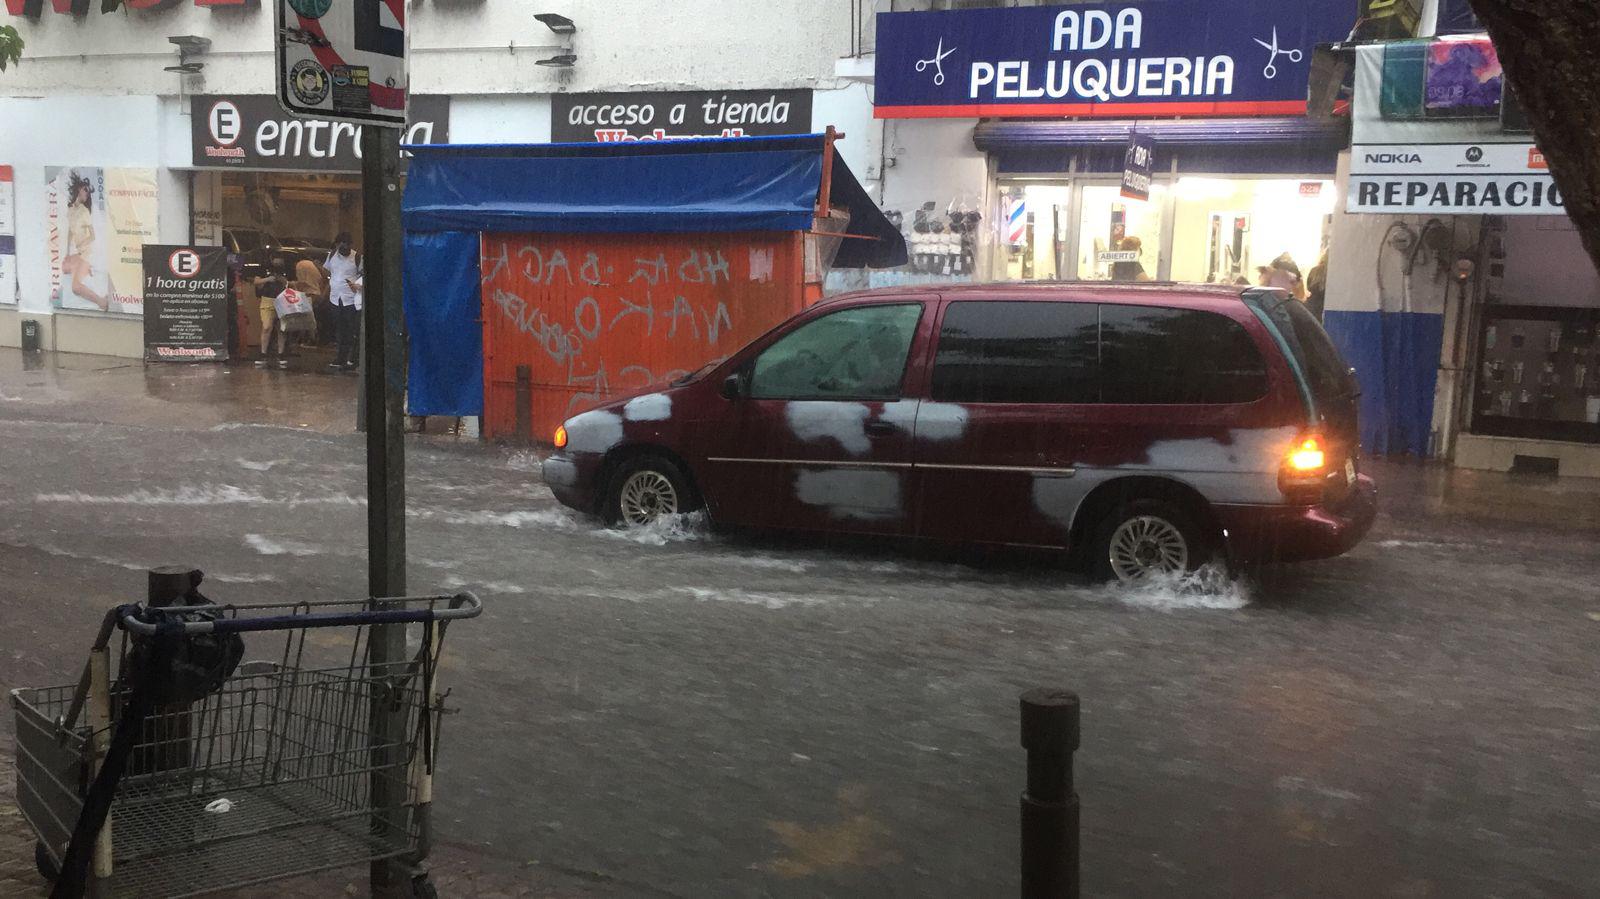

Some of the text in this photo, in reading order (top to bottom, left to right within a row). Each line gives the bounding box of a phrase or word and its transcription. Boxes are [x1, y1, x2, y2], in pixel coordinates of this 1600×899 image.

[1053, 7, 1142, 51] ADA
[969, 54, 1235, 102] PELUQUERIA
[217, 109, 234, 138] E
[568, 94, 791, 125] acceso a tienda
[1365, 153, 1422, 163] NOKIA
[49, 178, 60, 300] PRIMAVERA
[179, 253, 192, 273] E
[1100, 252, 1136, 260] ABIERTO
[147, 276, 225, 292] 1 hora gratis
